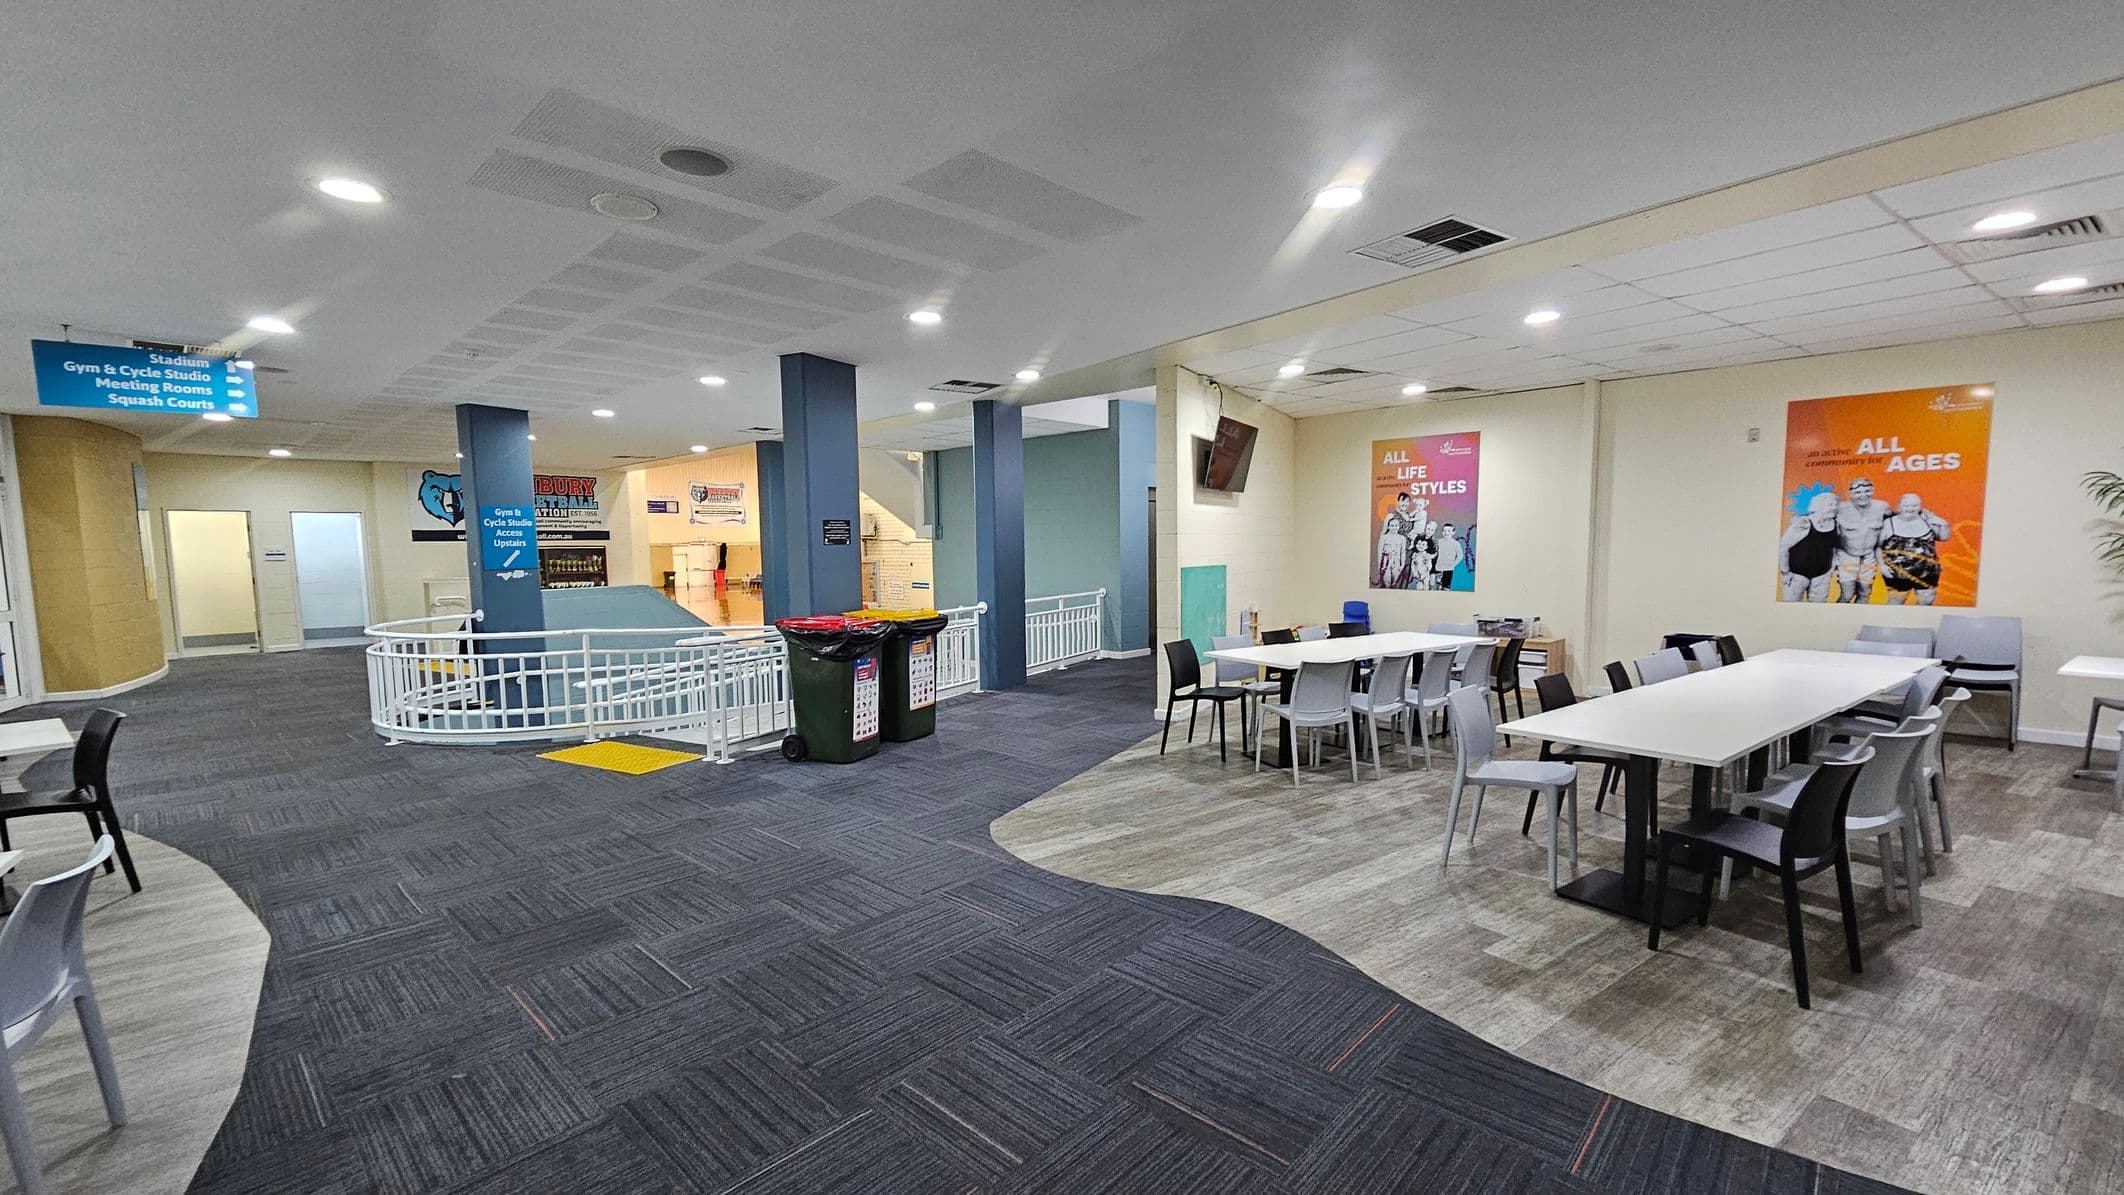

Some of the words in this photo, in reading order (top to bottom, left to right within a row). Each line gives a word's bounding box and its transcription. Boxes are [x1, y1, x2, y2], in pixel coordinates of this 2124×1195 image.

[149, 353, 210, 369] Stadium
[63, 361, 100, 374] Gym
[104, 363, 116, 375] &
[119, 365, 161, 380] Cycle
[164, 368, 211, 382] Studio
[95, 377, 160, 394] Meeting
[163, 382, 213, 396] Rooms
[108, 393, 164, 408] Squash
[167, 398, 215, 410] Courts
[1856, 436, 1905, 454] ALL
[1382, 450, 1410, 464] ALL
[1805, 458, 1866, 467] community
[1886, 452, 1961, 472] AGES
[1397, 465, 1428, 480] LIFE
[534, 475, 596, 496] BURY
[1411, 479, 1467, 495] STYLES
[535, 495, 598, 509] ETBALL
[494, 508, 513, 518] Gym
[514, 508, 522, 517] &
[535, 508, 568, 517] ATION
[483, 518, 506, 528] Cycle
[507, 518, 533, 527] Studio
[495, 529, 524, 537] Access
[493, 539, 527, 549] Upstairs
